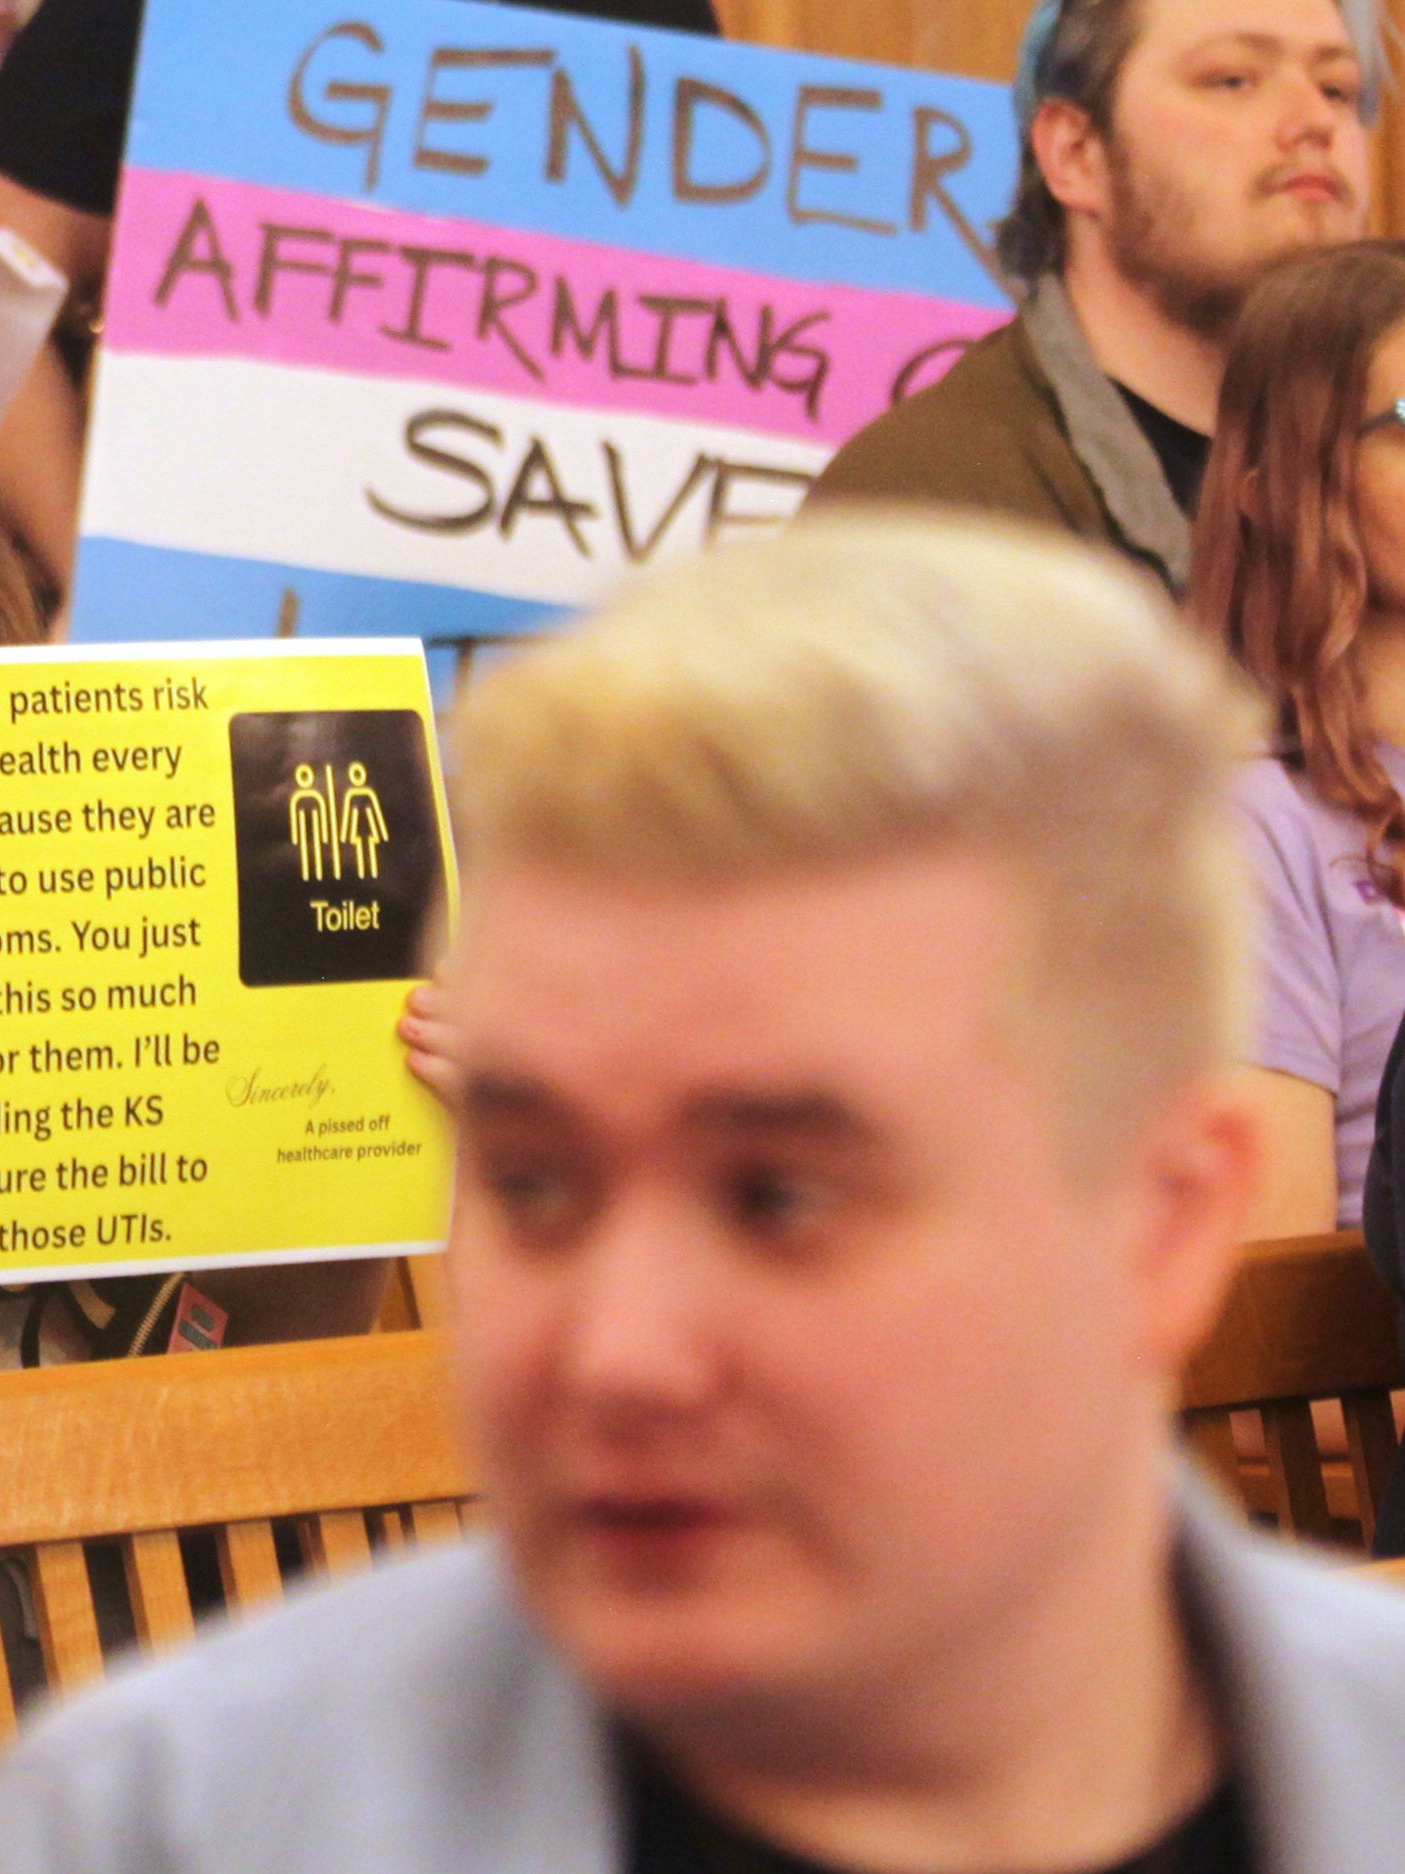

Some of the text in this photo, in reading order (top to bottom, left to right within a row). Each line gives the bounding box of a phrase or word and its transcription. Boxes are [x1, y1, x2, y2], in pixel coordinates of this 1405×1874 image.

[154, 197, 831, 422] AFFIRMING
[10, 683, 143, 724] patients
[153, 678, 208, 710] risk
[93, 747, 182, 779] every
[83, 800, 155, 839] they
[166, 804, 215, 829] are
[38, 869, 95, 894] use
[105, 856, 206, 900] public
[310, 900, 380, 932] Toilet
[71, 920, 130, 951] You
[140, 917, 202, 958] just
[61, 986, 97, 1012] so
[107, 974, 196, 1009] much
[29, 1039, 123, 1073] them.
[182, 1032, 220, 1065] be
[60, 1097, 114, 1131] the
[124, 1094, 164, 1127] KS
[305, 1114, 391, 1138] A pissed off
[56, 1158, 109, 1191] the
[119, 1152, 167, 1187] bill
[176, 1156, 208, 1183] to
[277, 1141, 422, 1164] healthcare provider
[96, 1213, 172, 1246] UTIs.
